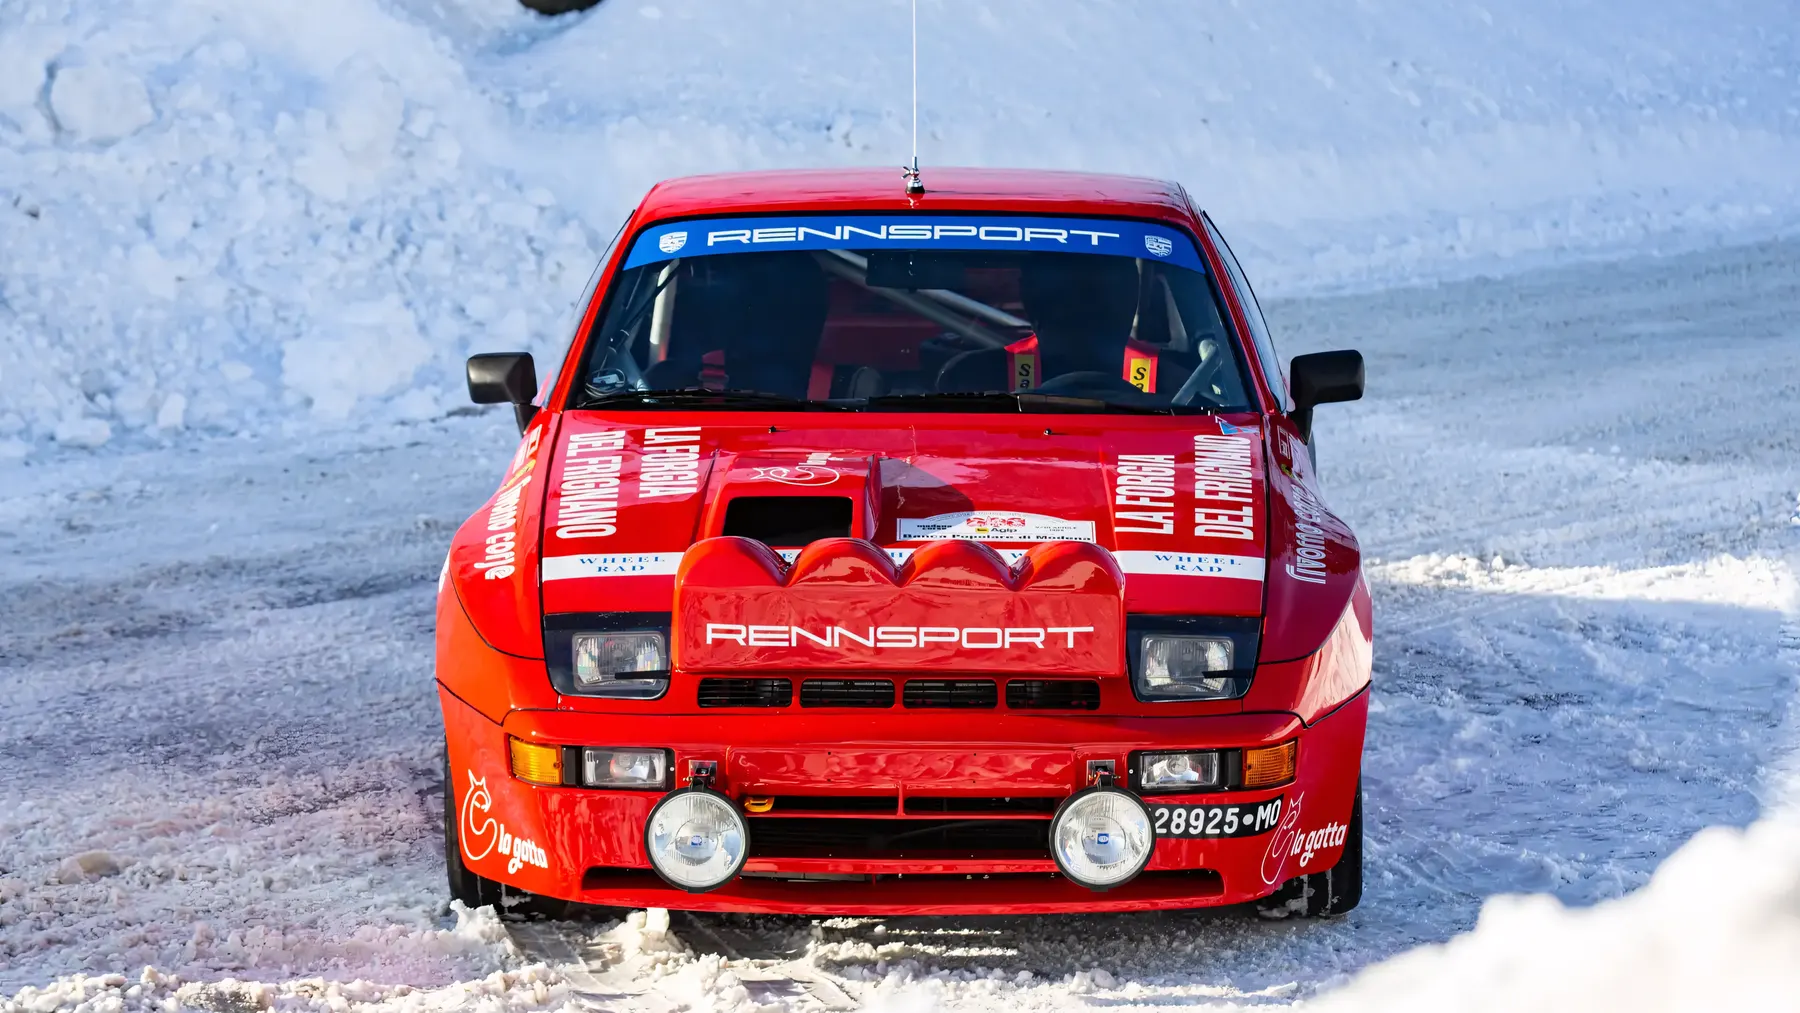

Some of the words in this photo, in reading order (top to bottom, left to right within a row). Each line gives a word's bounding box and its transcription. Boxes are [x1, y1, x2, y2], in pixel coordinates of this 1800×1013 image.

[707, 225, 1120, 246] RENNSPORT
[566, 430, 626, 457] DEL
[644, 427, 701, 444] LA
[639, 445, 700, 498] FORGIA
[1115, 454, 1176, 507] FORGIA
[1193, 434, 1253, 502] FRIGNANO
[556, 456, 623, 539] FRIGNANO
[1114, 511, 1174, 535] LA
[1194, 506, 1254, 540] DEL
[579, 556, 665, 564] WHEEL
[1154, 554, 1242, 566] WHEEL
[1174, 564, 1223, 573] RAD
[705, 623, 1094, 649] RENNSPORT
[497, 824, 512, 855] la
[512, 836, 549, 874] gatta
[1290, 828, 1304, 857] la
[1299, 821, 1347, 867] gatta
